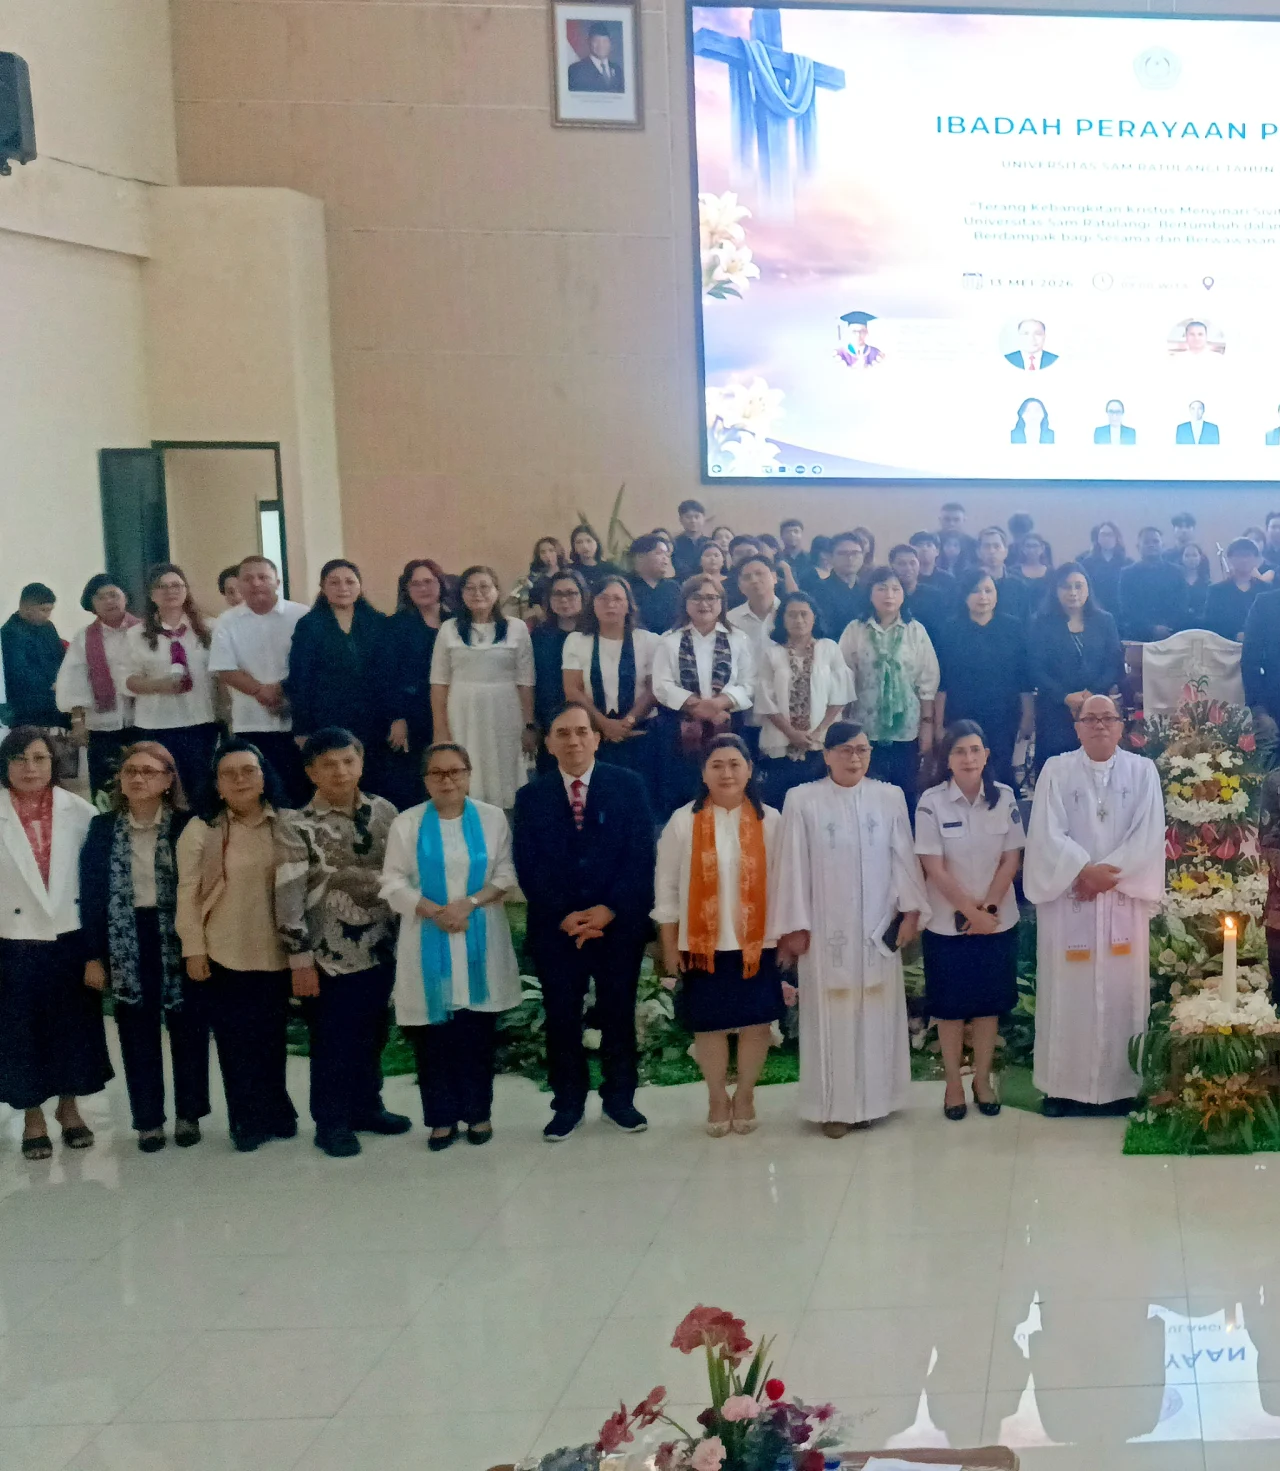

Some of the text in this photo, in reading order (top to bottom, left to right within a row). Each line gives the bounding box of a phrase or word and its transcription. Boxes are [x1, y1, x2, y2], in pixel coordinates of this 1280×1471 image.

[935, 115, 1062, 136] IBADAH
[1075, 117, 1248, 140] PERAYAAN
[1001, 160, 1097, 170] UNIVERSITAS
[1101, 162, 1133, 171] SAM
[1137, 162, 1219, 173] RATULANGI
[1225, 164, 1274, 173] TAHUN
[1030, 203, 1122, 214] Kebangkitan
[1126, 204, 1176, 214] Kristus
[1179, 205, 1250, 217] Menyinari
[963, 216, 1043, 227] Universitas
[1048, 217, 1079, 227] Sam
[1158, 219, 1240, 230] Bertumbuh
[973, 231, 1056, 244] Berdampak
[1061, 232, 1092, 244] bagi
[1096, 233, 1151, 243] Sesama
[1155, 233, 1181, 243] dan
[1185, 234, 1276, 245] Berwawasan
[1008, 279, 1035, 288] MEI
[1040, 279, 1074, 289] 2026
